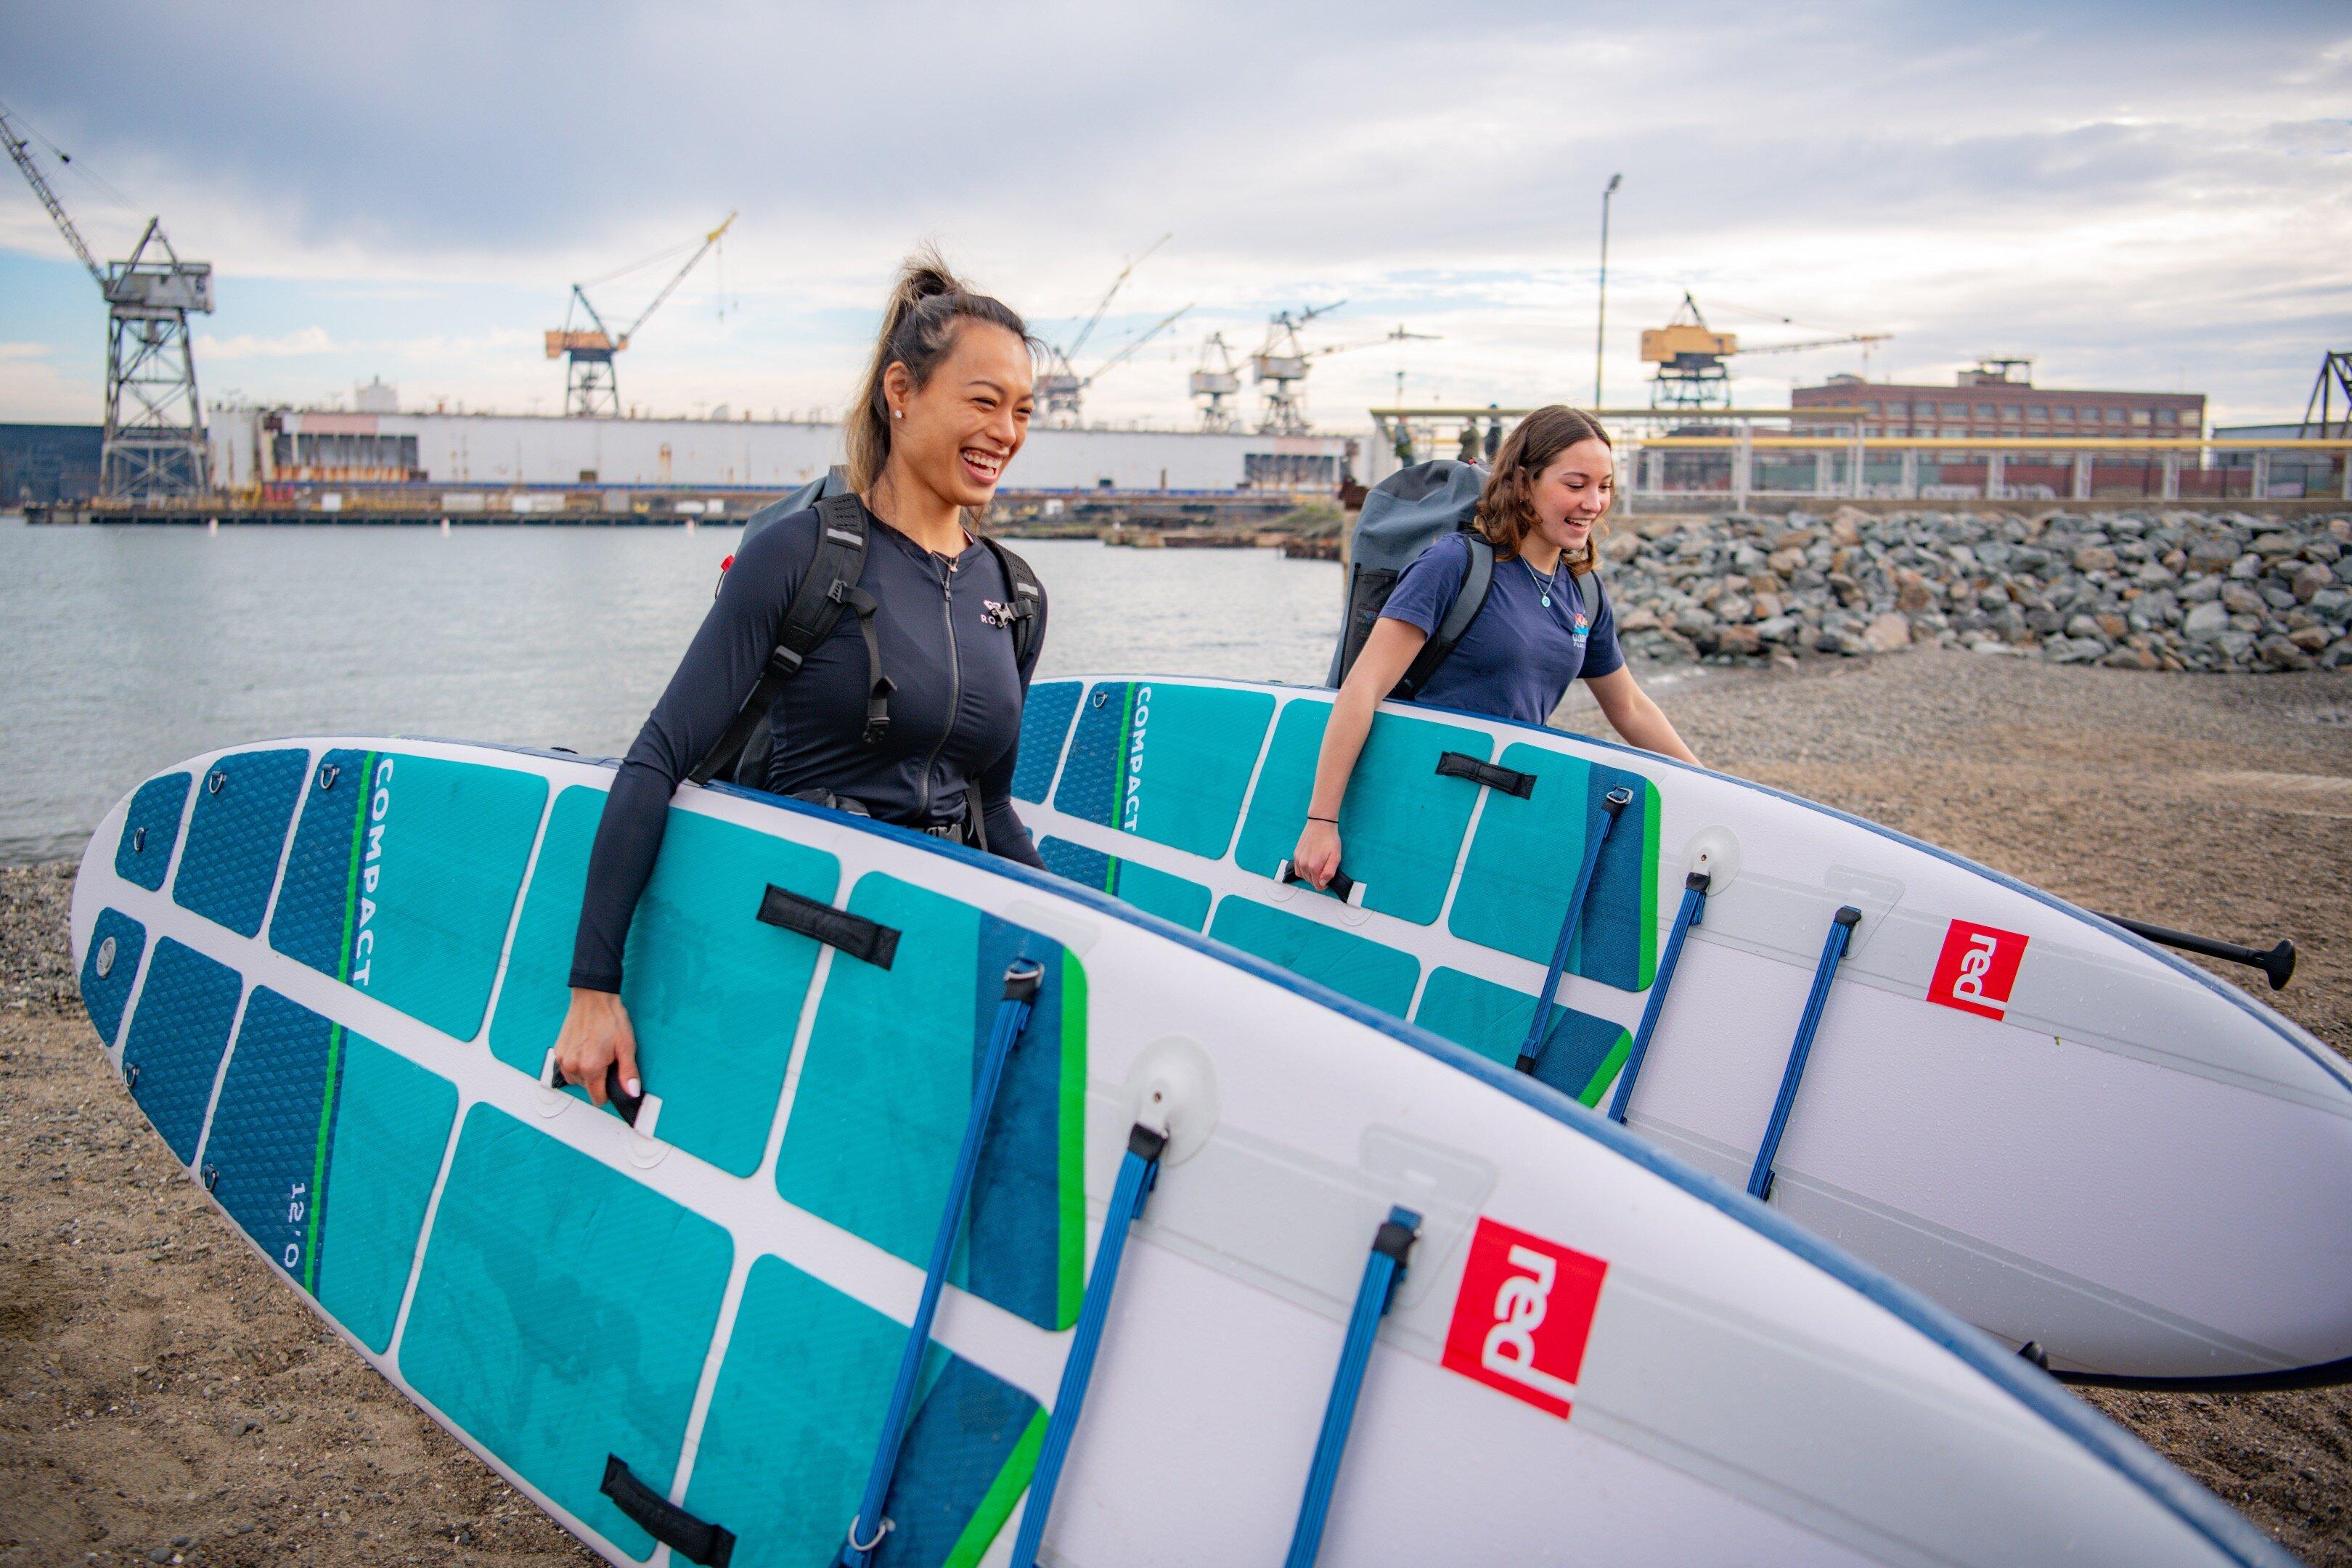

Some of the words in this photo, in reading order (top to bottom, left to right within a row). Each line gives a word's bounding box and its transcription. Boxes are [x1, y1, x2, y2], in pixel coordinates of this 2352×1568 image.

[1124, 686, 1151, 832] COMPACT
[353, 758, 393, 987] COMPACT
[1952, 933, 2006, 1010] red
[1481, 1244, 1576, 1402] red
